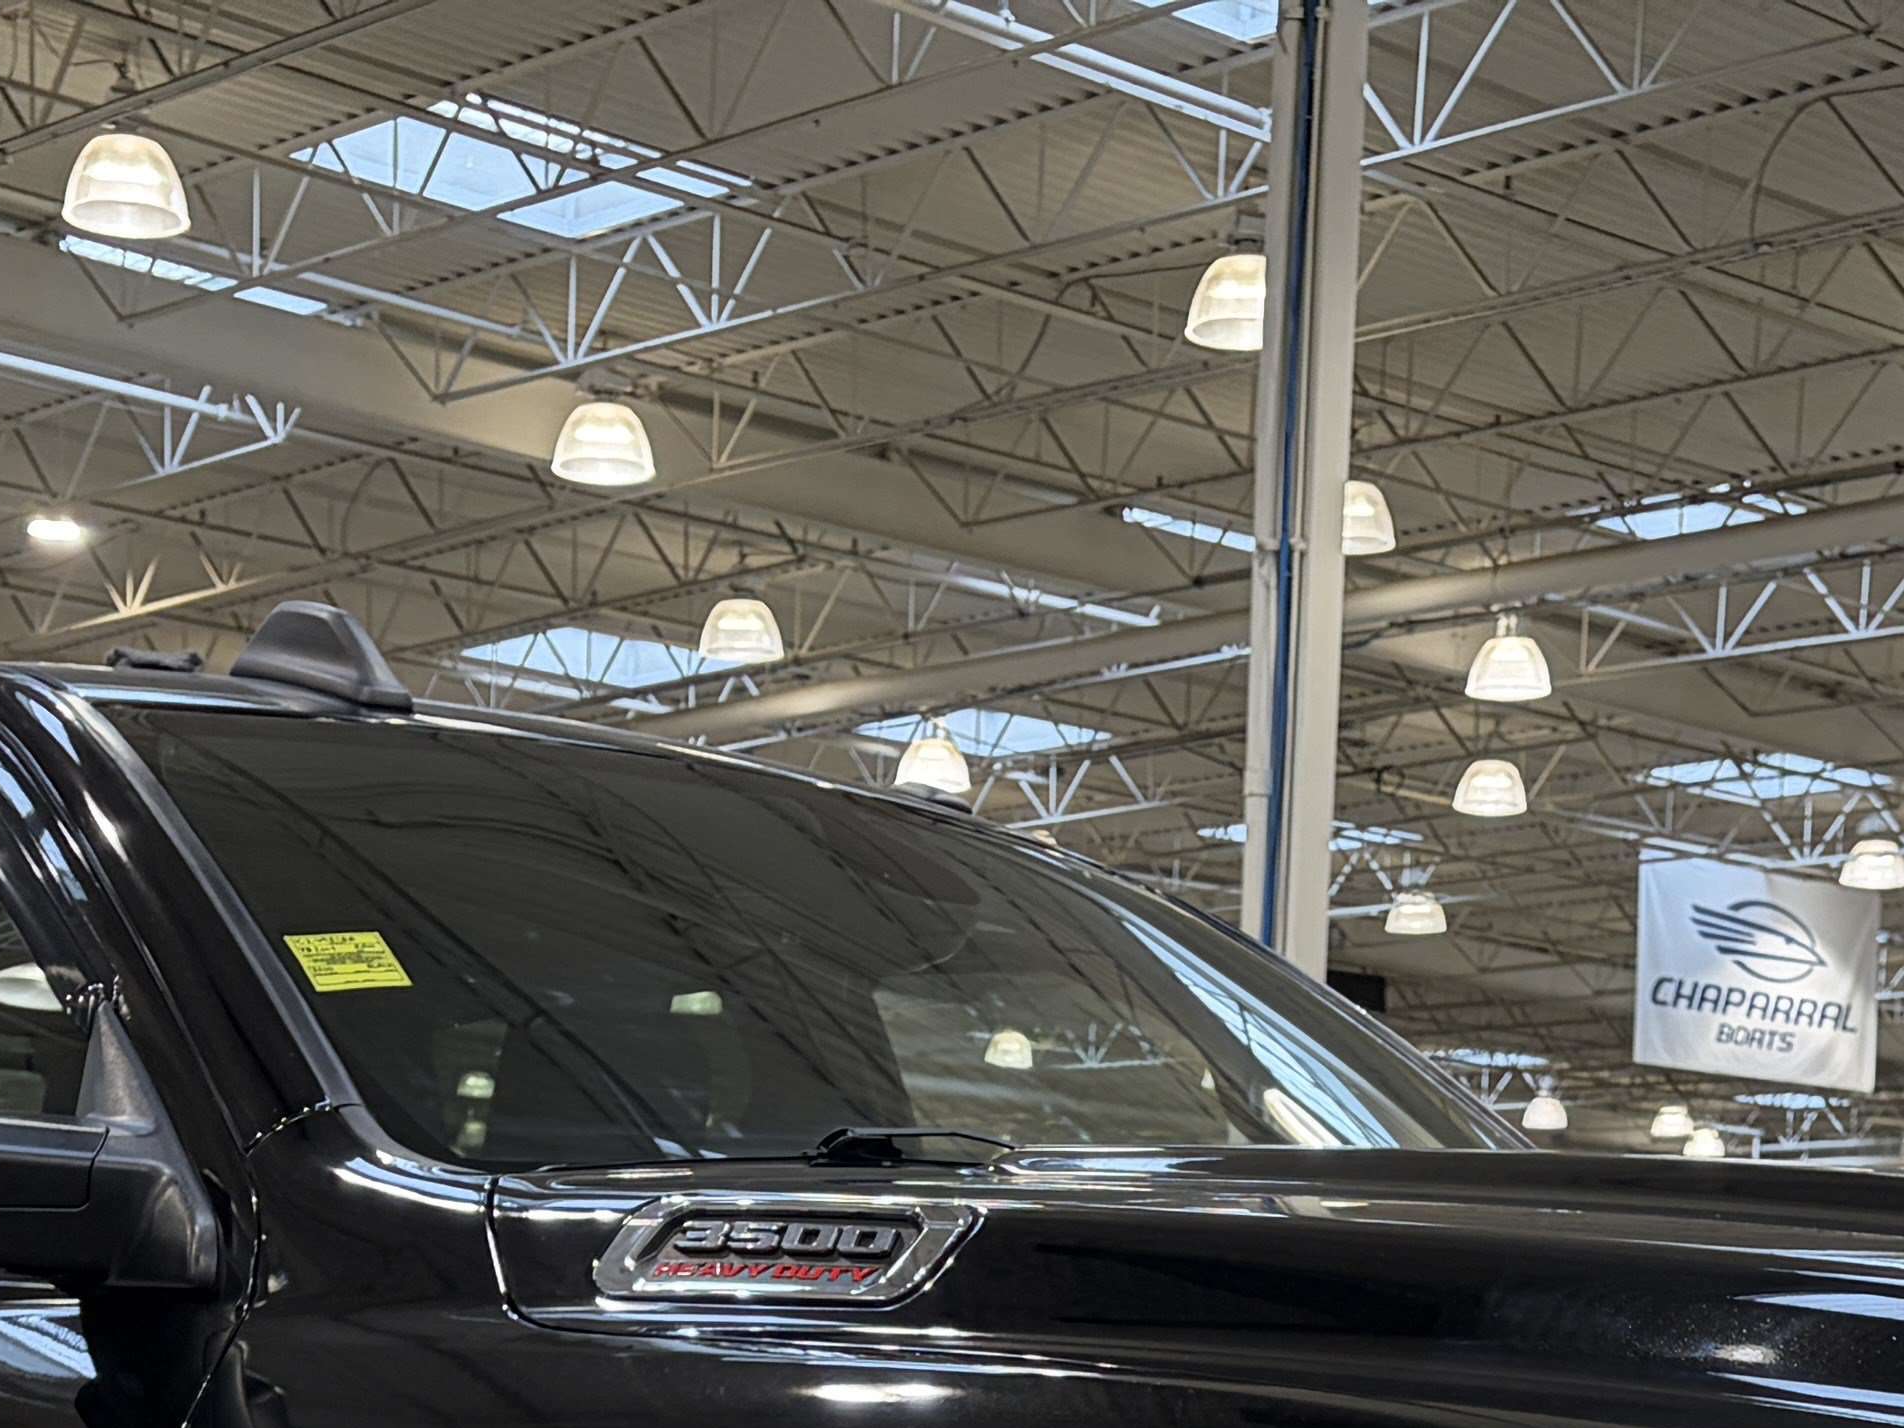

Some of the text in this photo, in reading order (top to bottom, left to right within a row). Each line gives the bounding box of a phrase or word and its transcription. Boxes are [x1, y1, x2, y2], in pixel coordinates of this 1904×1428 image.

[1651, 976, 1859, 1034] CHAPARRAL
[1715, 1022, 1796, 1053] BOATS
[673, 1219, 899, 1257] 3500
[653, 1261, 882, 1282] HEAVY DUTY
